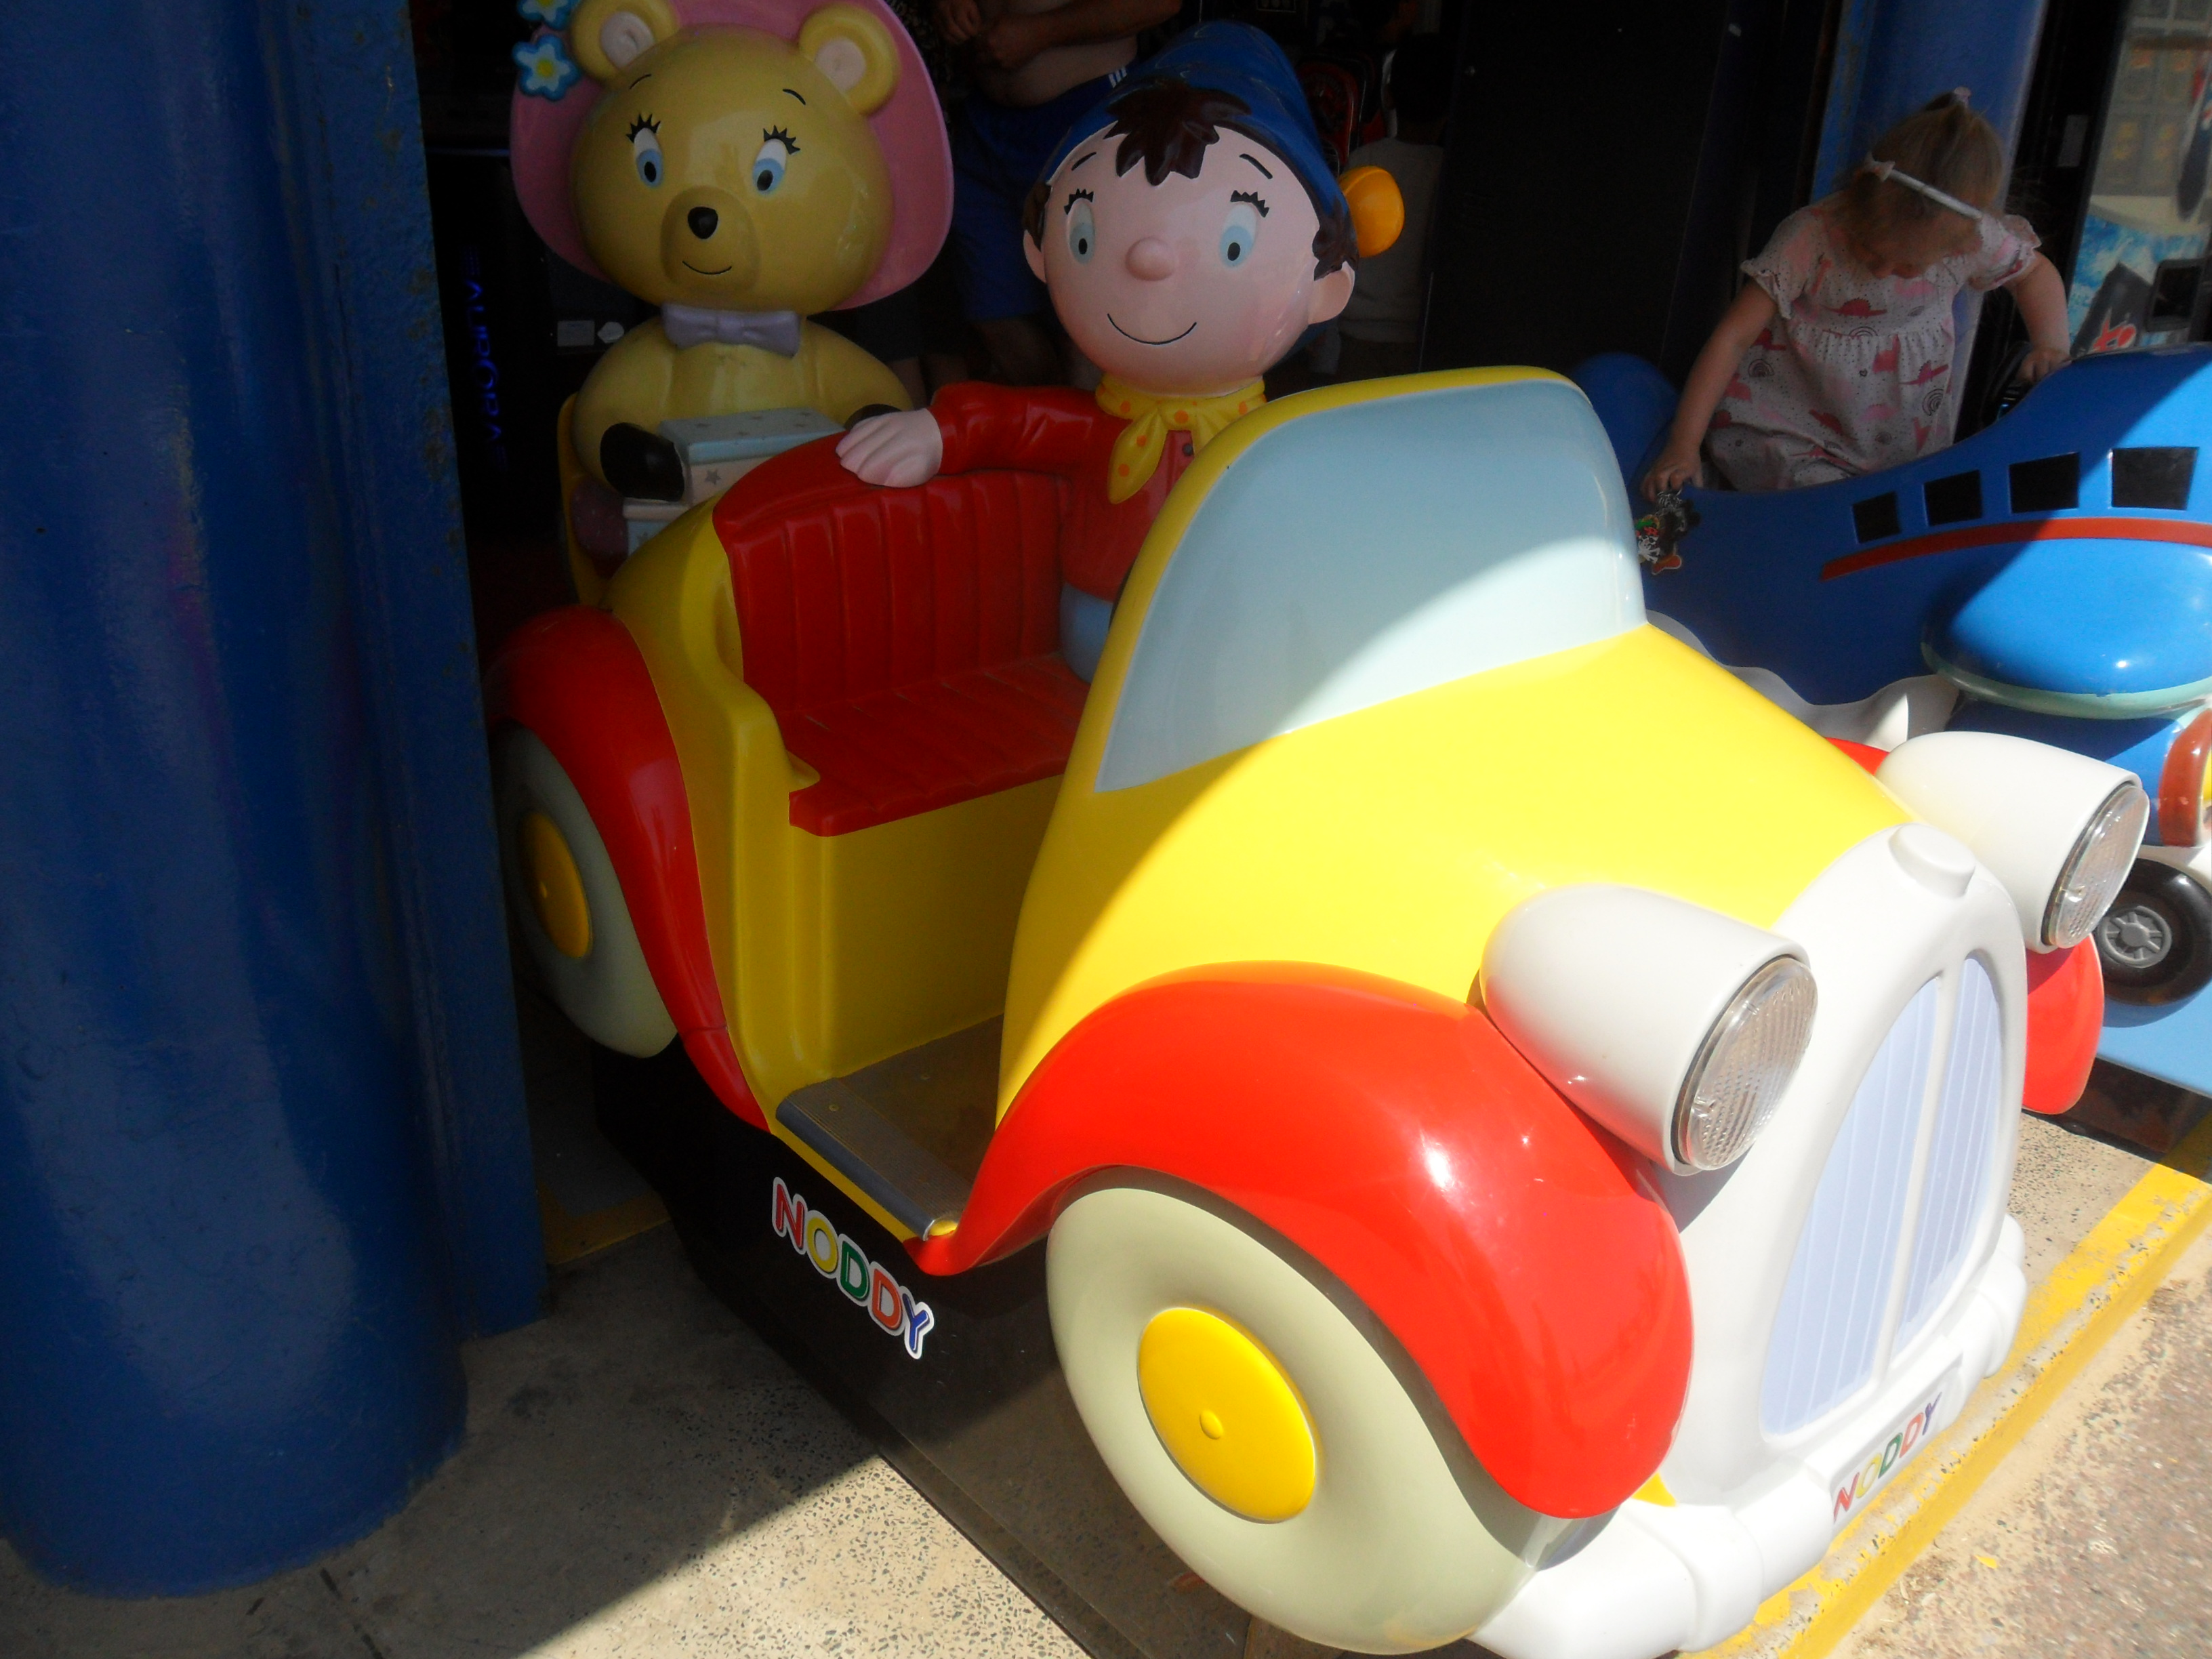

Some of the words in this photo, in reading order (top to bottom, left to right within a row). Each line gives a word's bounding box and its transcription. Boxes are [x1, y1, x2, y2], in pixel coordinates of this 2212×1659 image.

[462, 278, 502, 442] AURORA
[773, 1178, 934, 1359] NODDY
[1833, 1391, 1942, 1524] NODDY
